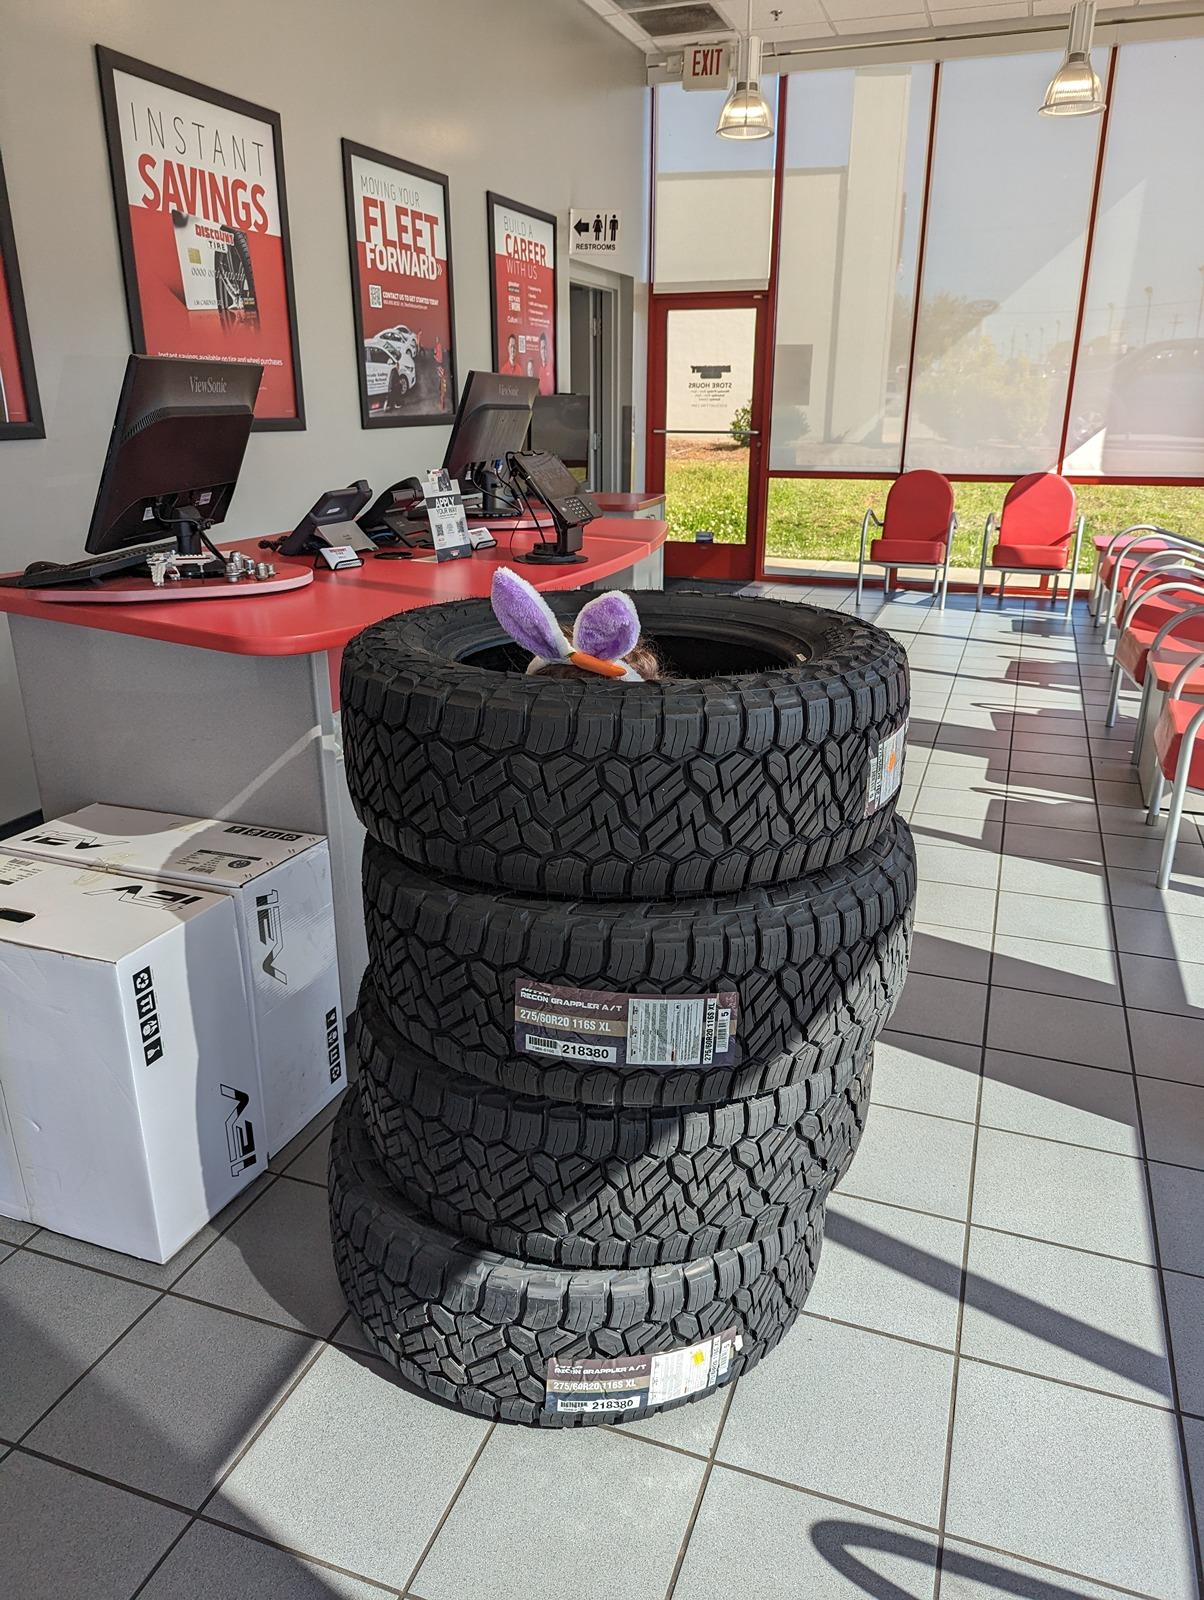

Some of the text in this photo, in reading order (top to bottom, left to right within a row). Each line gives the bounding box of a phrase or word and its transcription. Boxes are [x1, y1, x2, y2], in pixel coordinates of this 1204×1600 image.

[692, 48, 723, 76] EXIT
[130, 102, 264, 176] INSTANT
[137, 153, 268, 234] SAVINGS
[361, 175, 420, 208] MOVING YOUR
[195, 224, 234, 246] DISCOUNT
[363, 196, 438, 258] FLEET
[503, 216, 534, 238] BUILD A
[208, 241, 226, 251] TIRE
[505, 234, 547, 266] CAREER
[575, 243, 616, 251] RESTROOMS
[365, 242, 437, 281] FORWARD
[506, 260, 538, 280] WITH US
[189, 376, 227, 393] ViewSonic
[436, 496, 455, 509] APPLY
[520, 991, 623, 1012] RECON GRAPPLER A/T
[520, 1009, 611, 1032] 275/60R20 116S XL
[704, 1002, 715, 1062] 275/60R20 116S XL
[562, 1044, 609, 1059] 218380
[583, 1367, 627, 1375] GRAPPLER
[553, 1379, 637, 1391] 275/60R20 116S XL
[592, 1399, 634, 1410] 218380
